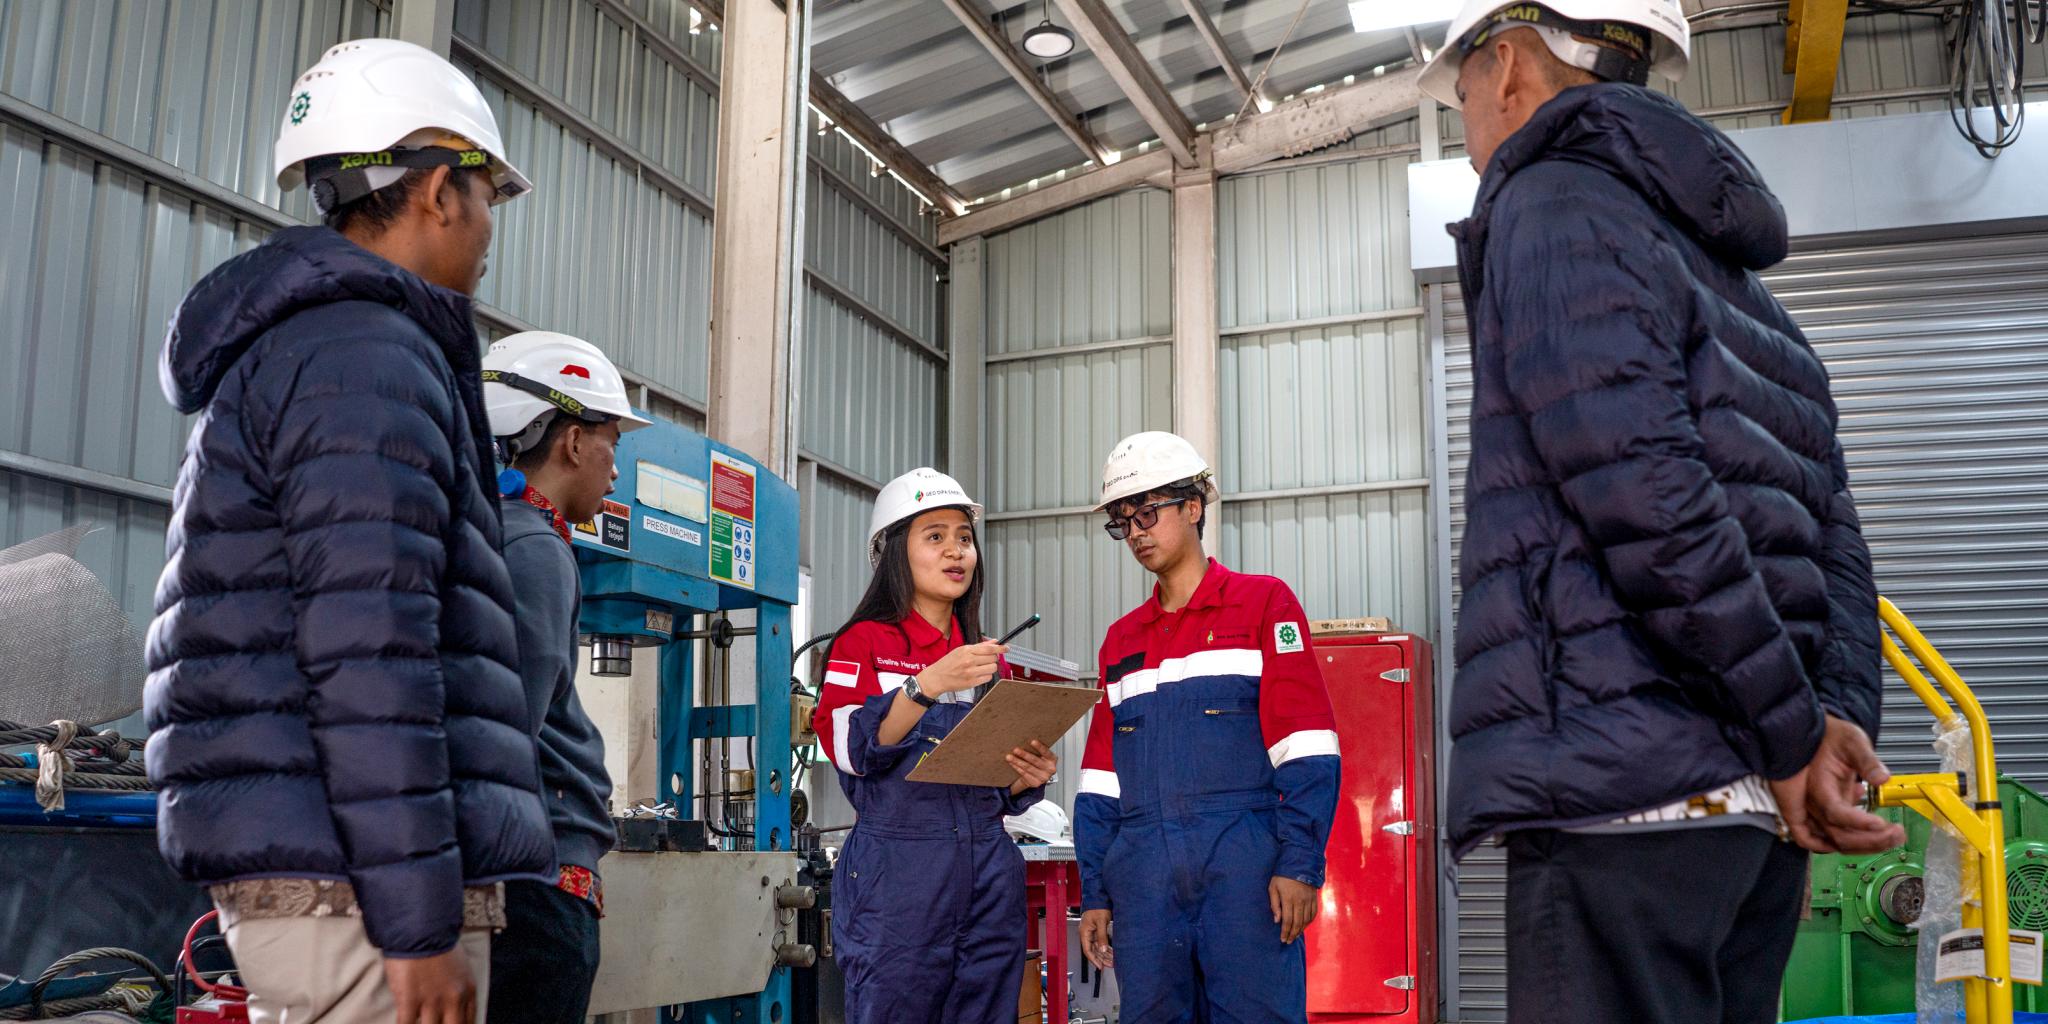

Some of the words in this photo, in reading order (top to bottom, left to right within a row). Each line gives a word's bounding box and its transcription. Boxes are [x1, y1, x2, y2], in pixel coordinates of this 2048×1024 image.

[341, 152, 392, 169] uvex
[459, 152, 486, 165] ex
[481, 370, 501, 380] ex
[549, 389, 585, 415] uvex
[608, 521, 624, 533] Bahaya
[646, 518, 669, 534] PRESS
[669, 526, 699, 543] MACHINE
[608, 530, 624, 542] Terjepit
[877, 656, 899, 667] Eveline
